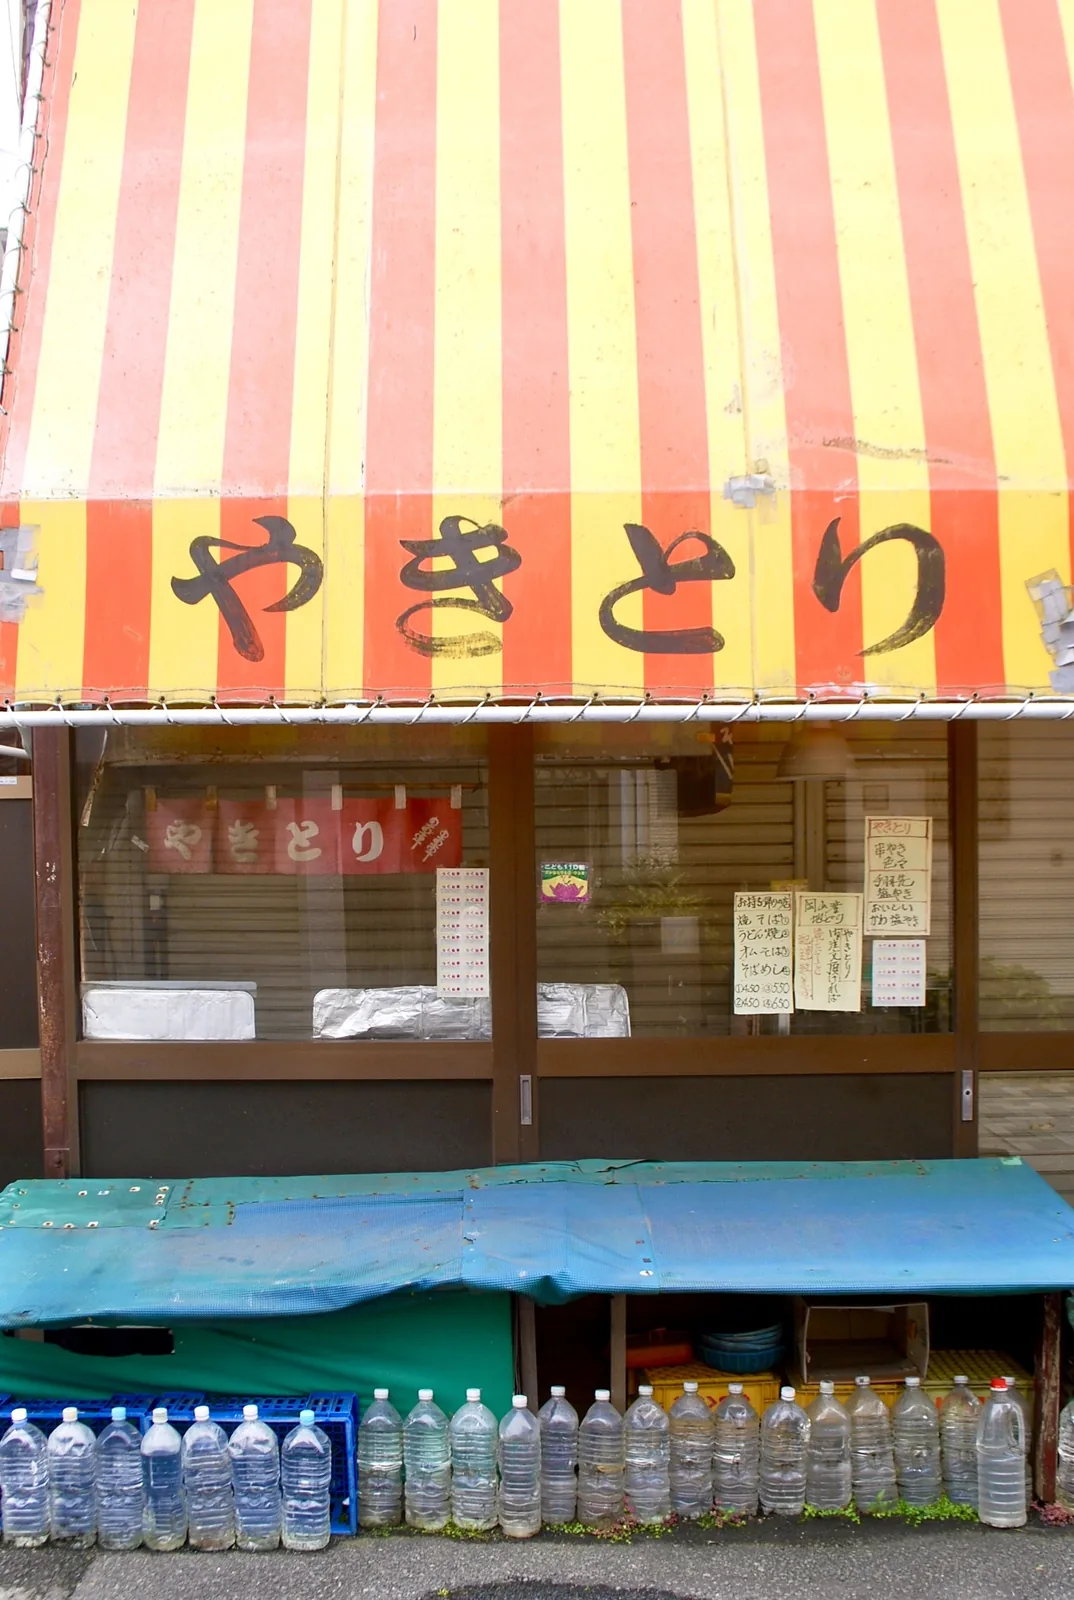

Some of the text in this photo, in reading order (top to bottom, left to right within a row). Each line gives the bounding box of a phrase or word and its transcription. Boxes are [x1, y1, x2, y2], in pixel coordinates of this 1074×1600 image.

[171, 514, 946, 662] やきとり
[163, 819, 384, 862] やきとり
